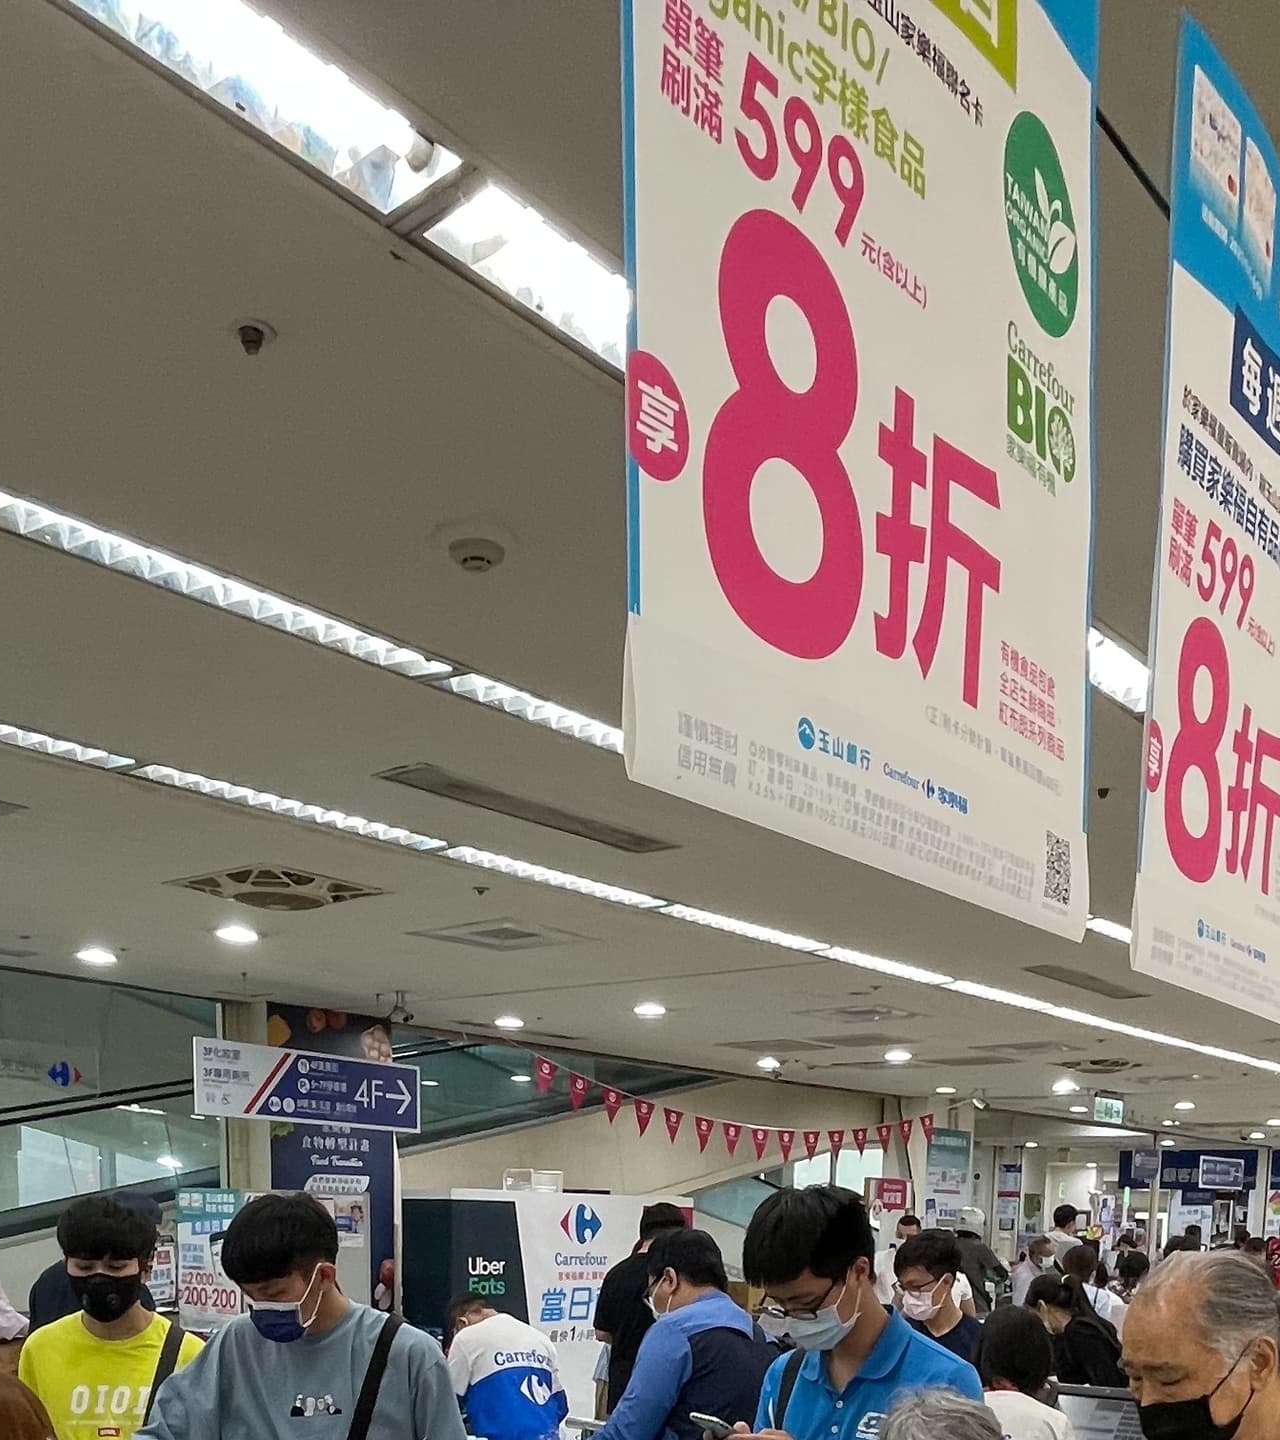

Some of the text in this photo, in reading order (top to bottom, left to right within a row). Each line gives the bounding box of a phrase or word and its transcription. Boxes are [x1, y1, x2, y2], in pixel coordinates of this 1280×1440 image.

[661, 44, 723, 145] 刷滿
[733, 51, 865, 248] 599
[1006, 320, 1077, 417] Carrefour
[635, 374, 680, 457] 享
[1196, 519, 1255, 631] 599
[353, 1078, 385, 1110] 4F
[468, 1255, 506, 1276] Uber
[468, 1276, 507, 1296] Eats
[554, 1252, 608, 1267] Carrefour
